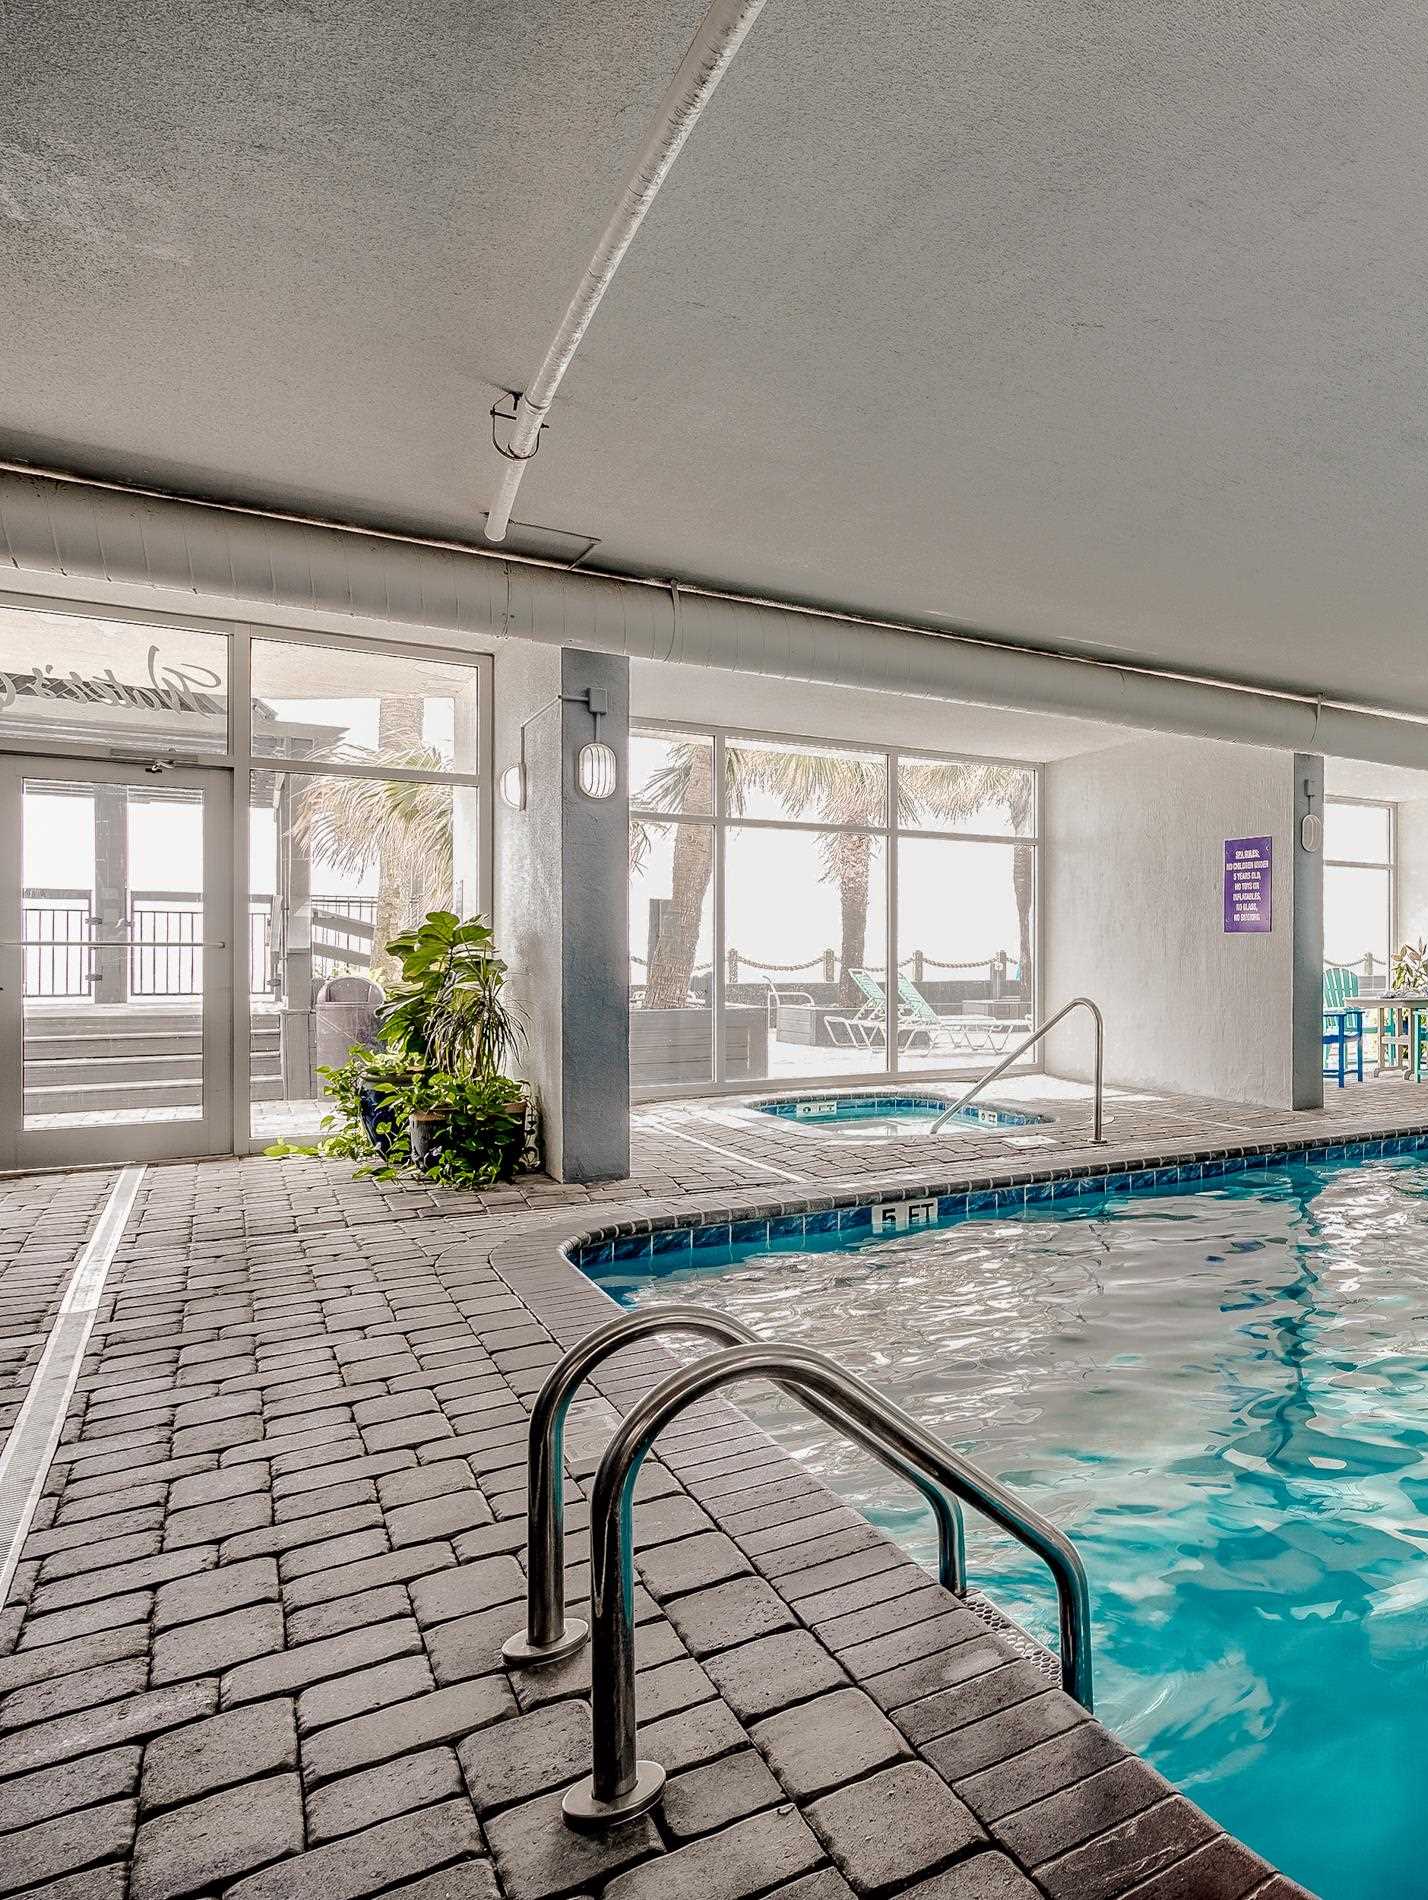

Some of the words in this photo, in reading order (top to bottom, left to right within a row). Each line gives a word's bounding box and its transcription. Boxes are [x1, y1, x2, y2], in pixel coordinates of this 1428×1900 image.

[1234, 883, 1241, 891] NO
[1234, 914, 1240, 922] NO
[909, 1202, 934, 1223] FT
